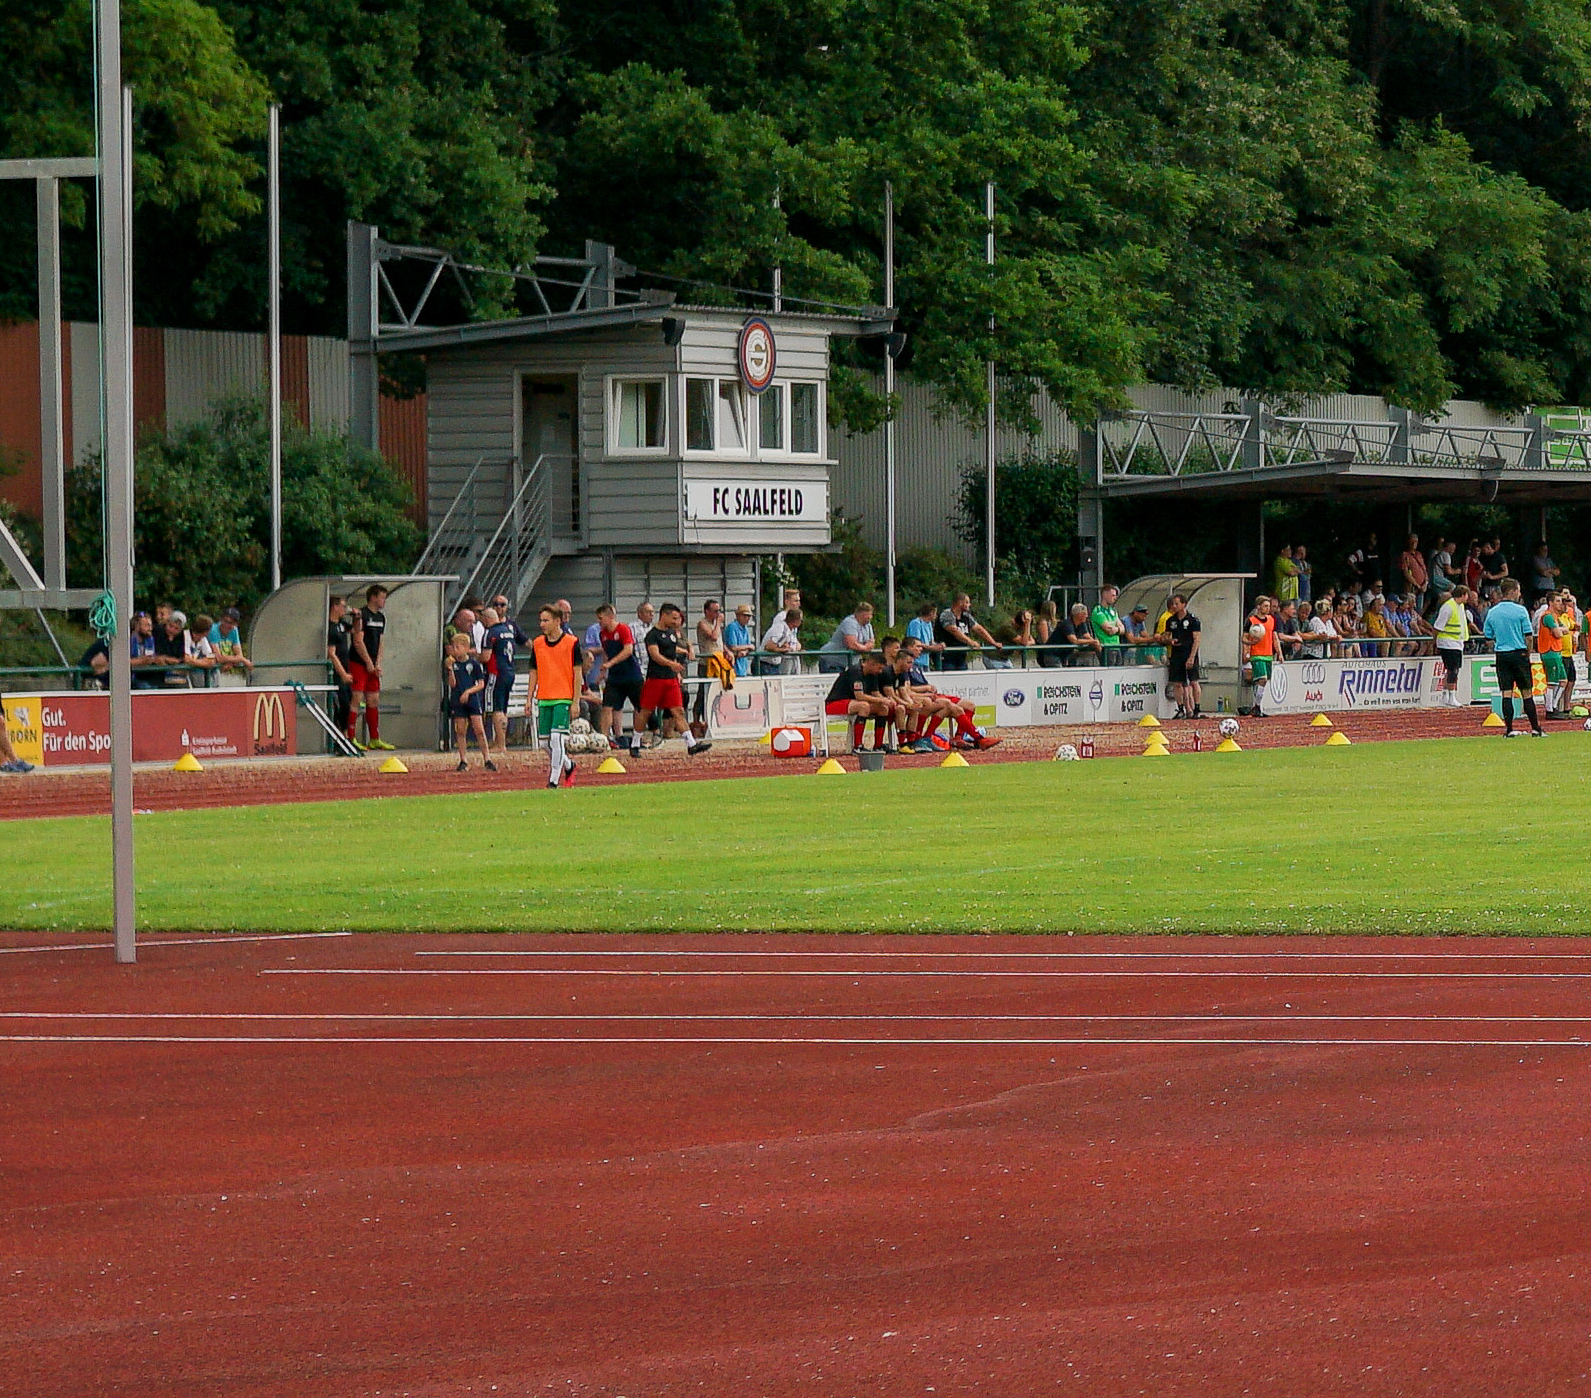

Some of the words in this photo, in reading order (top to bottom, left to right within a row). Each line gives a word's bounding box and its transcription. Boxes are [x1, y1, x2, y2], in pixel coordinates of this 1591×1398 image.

[713, 488, 729, 515] FC
[735, 487, 803, 516] SAALFELD
[42, 707, 66, 727] Gut.
[43, 731, 62, 751] Für
[65, 732, 85, 751] den
[89, 729, 110, 754] Spo
